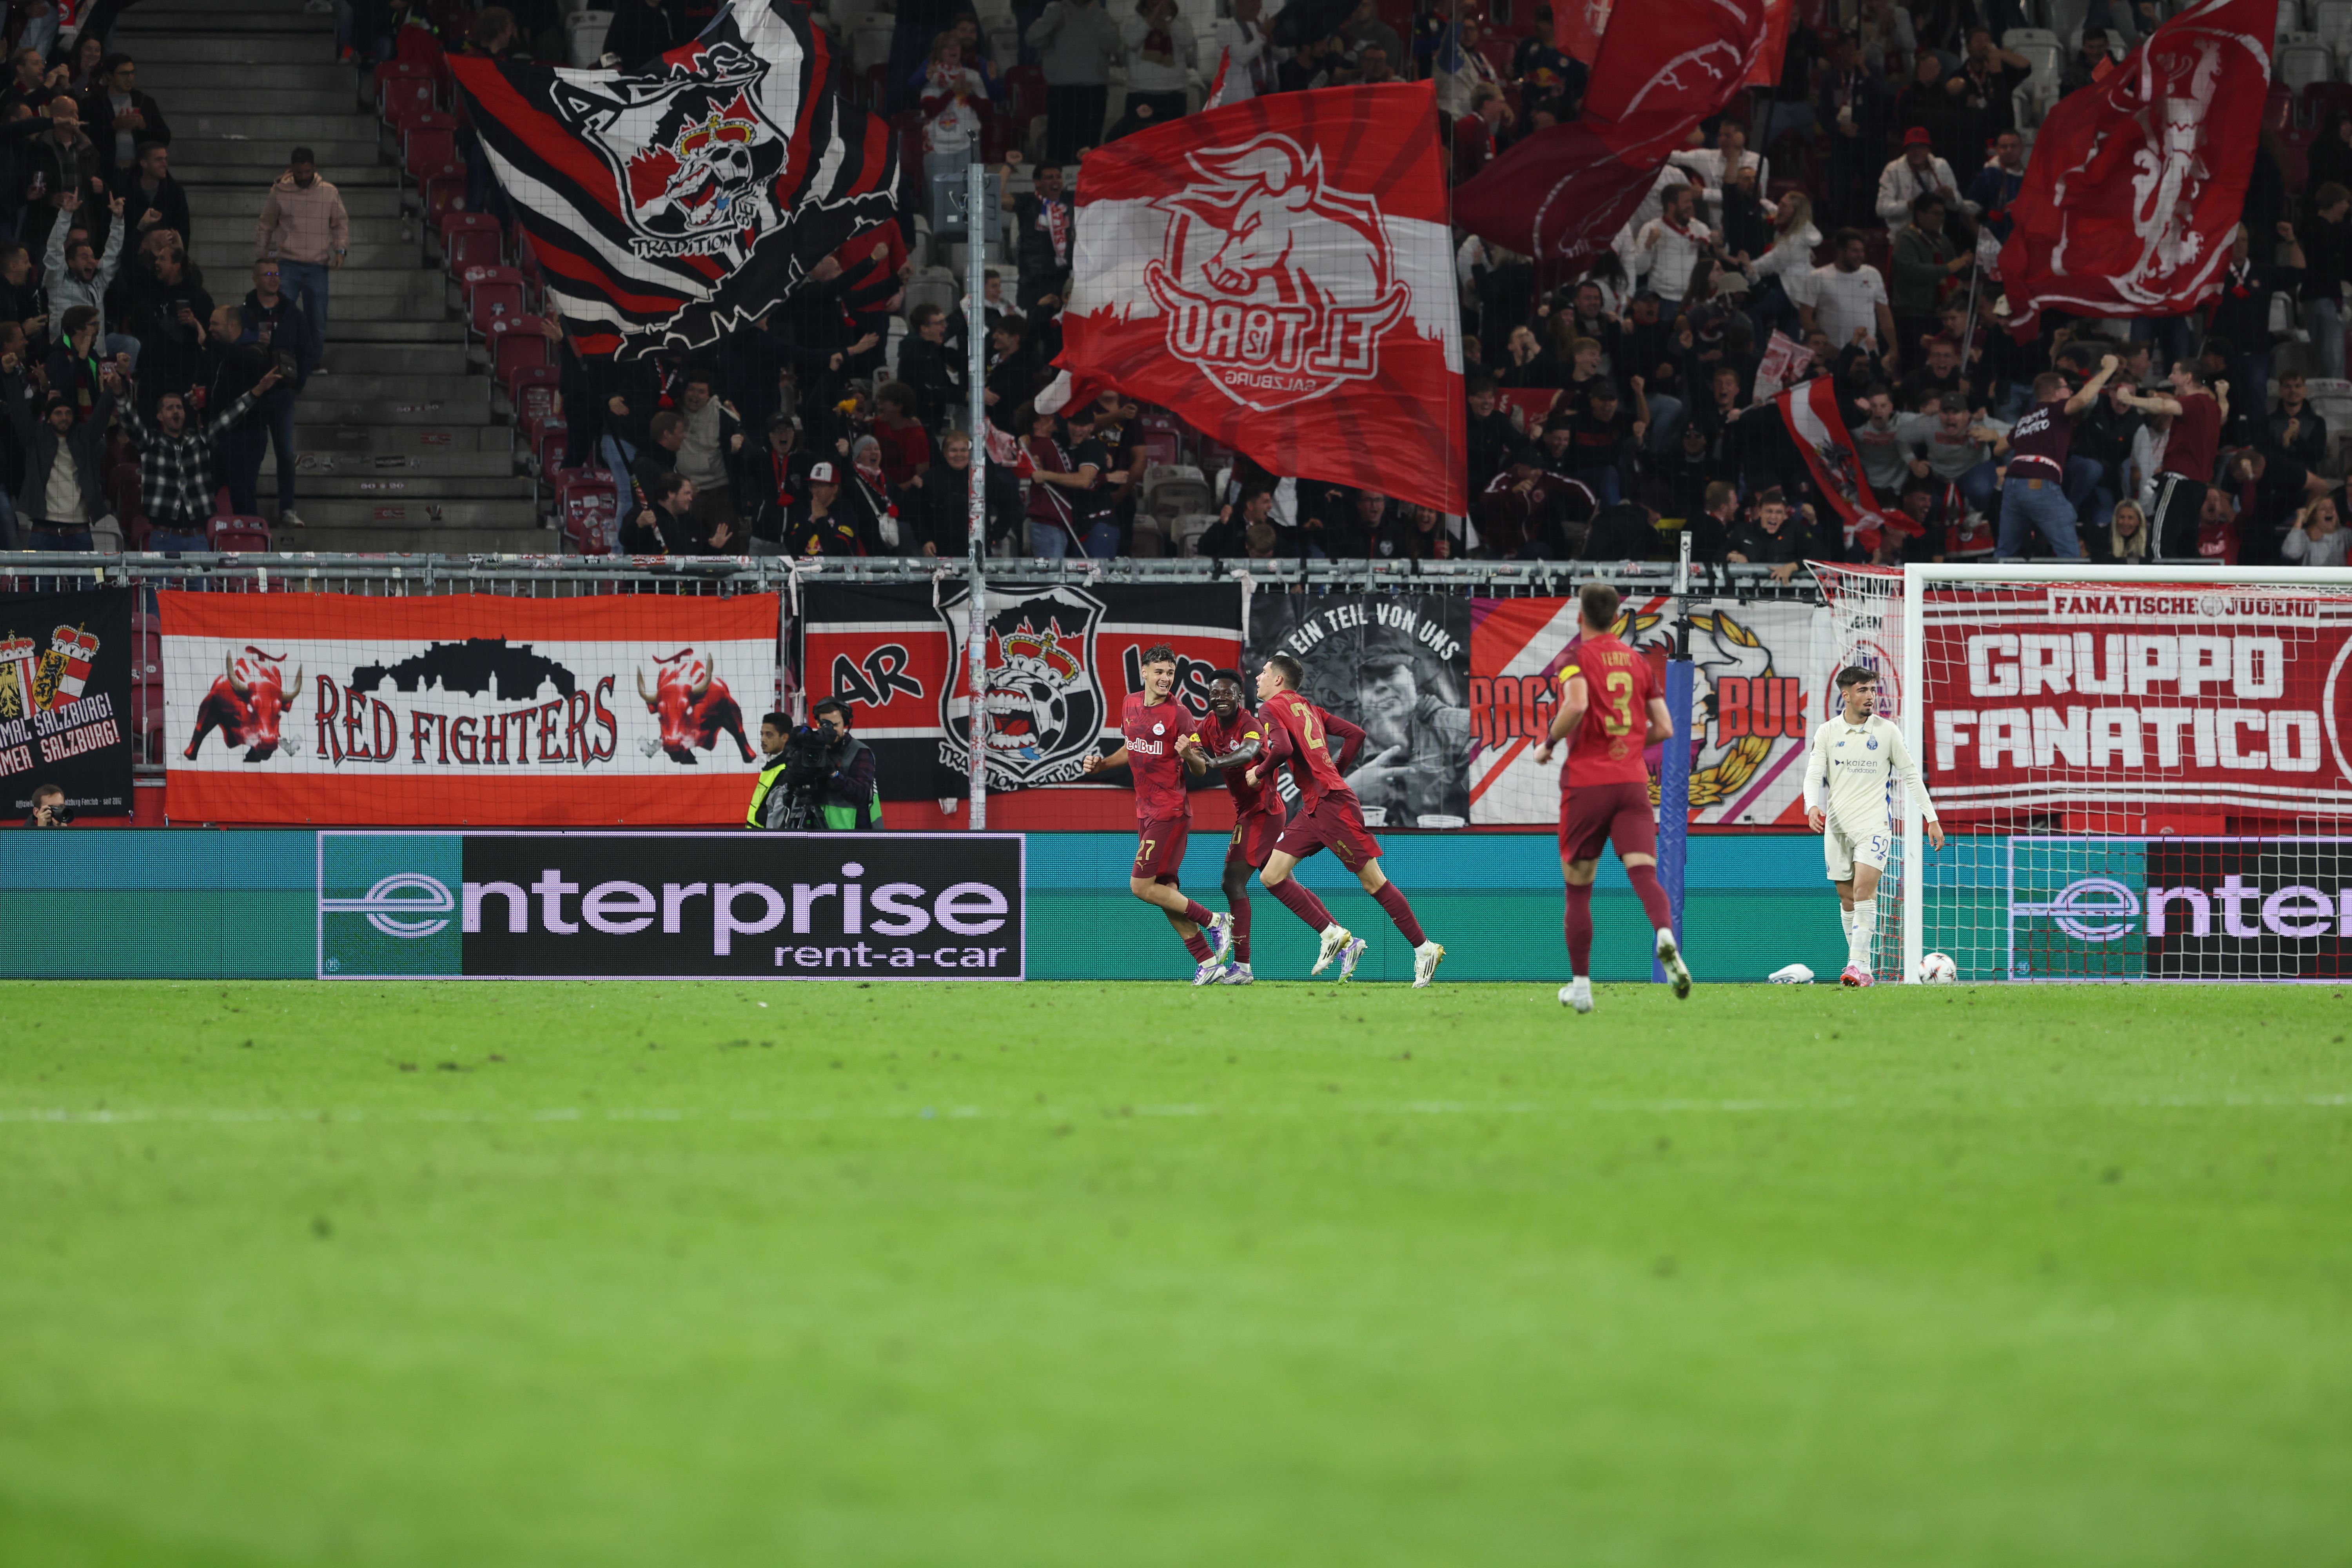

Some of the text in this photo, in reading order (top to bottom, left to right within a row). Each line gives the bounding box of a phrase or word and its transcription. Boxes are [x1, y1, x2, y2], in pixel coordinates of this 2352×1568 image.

[1288, 603, 1460, 661] EIN TEIL VON UNS
[2054, 596, 2319, 617] FANATISCHE JUGEND
[831, 644, 924, 708] AR
[1967, 632, 2284, 699] GRUPPO
[0, 692, 113, 748] MAL SALZBURG!
[315, 673, 618, 769] RED FIGHTERS
[1470, 675, 1563, 751] RAG
[1605, 671, 1633, 736] 3
[0, 719, 121, 777] MER SALZBURG!
[1933, 705, 2321, 772] FANATICO
[1135, 839, 1156, 861] 27
[1870, 835, 1889, 857] 52
[365, 861, 1009, 956] enterprise
[2053, 874, 2352, 940] ente
[774, 941, 1006, 967] rent-a-car
